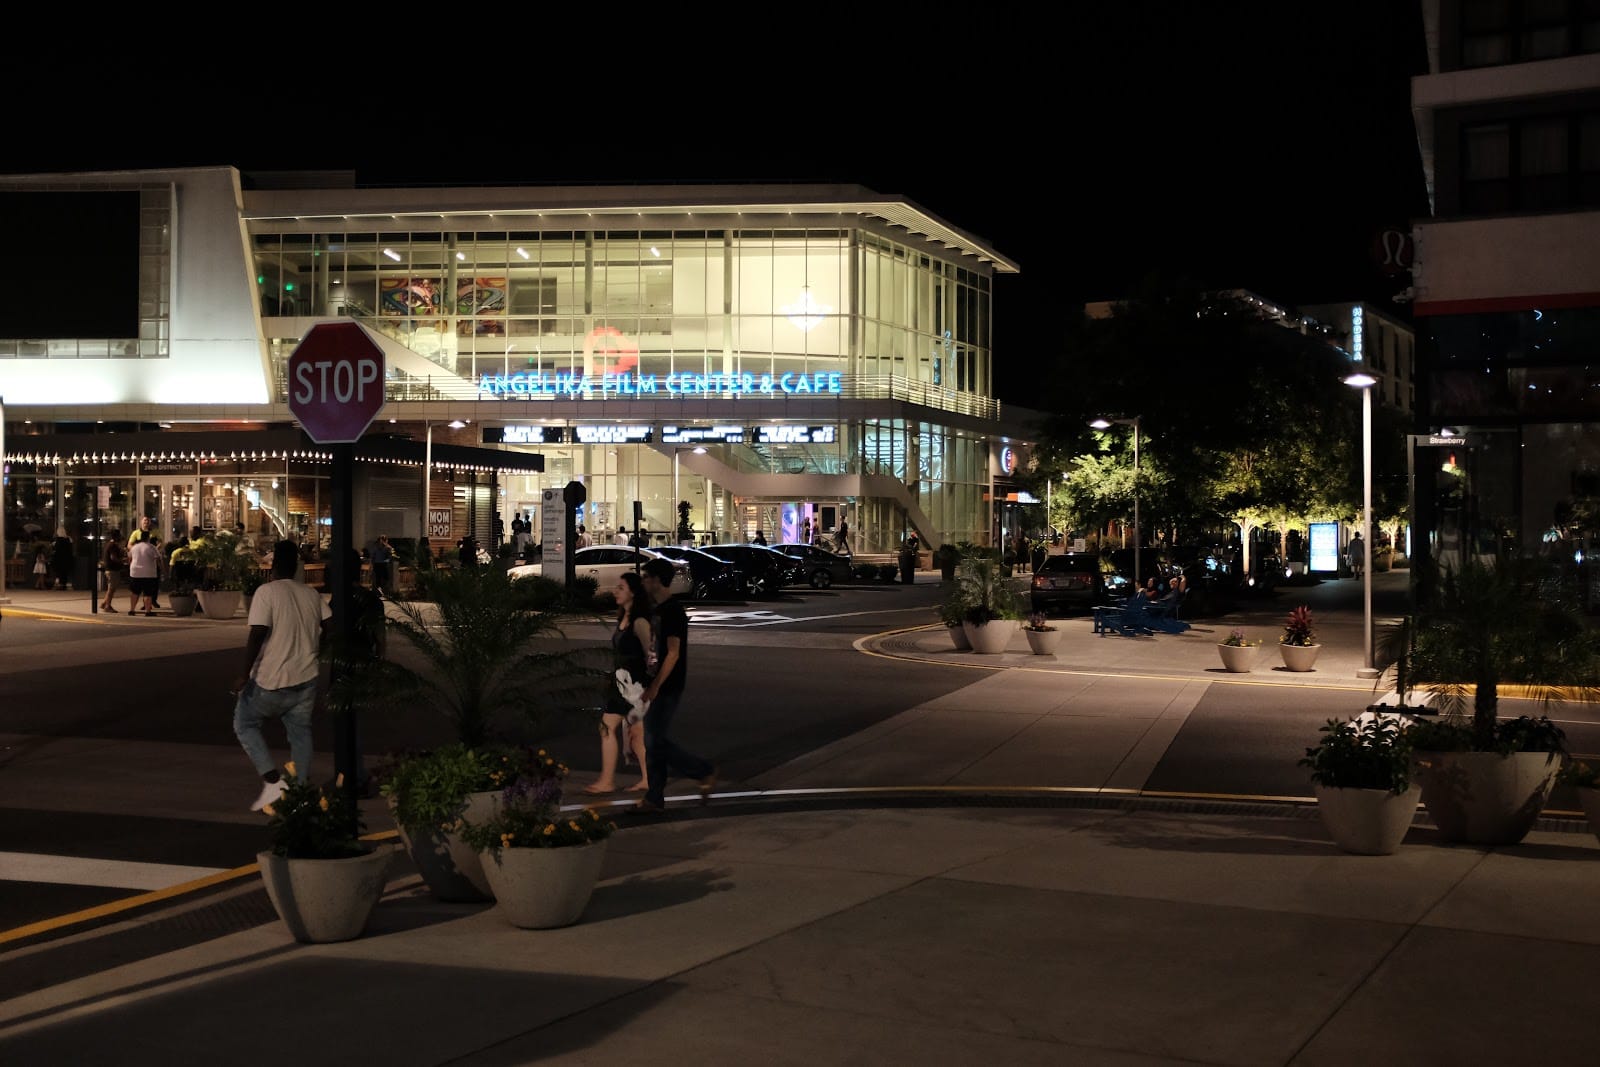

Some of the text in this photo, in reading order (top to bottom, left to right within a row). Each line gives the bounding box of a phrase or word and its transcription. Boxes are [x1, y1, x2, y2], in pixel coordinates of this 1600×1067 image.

[295, 360, 377, 404] STOP
[479, 373, 841, 394] ANGELIKA FILM CENTER & CAFE
[1430, 437, 1466, 446] Strawberry
[430, 511, 449, 523] MOM
[433, 525, 449, 536] POP
